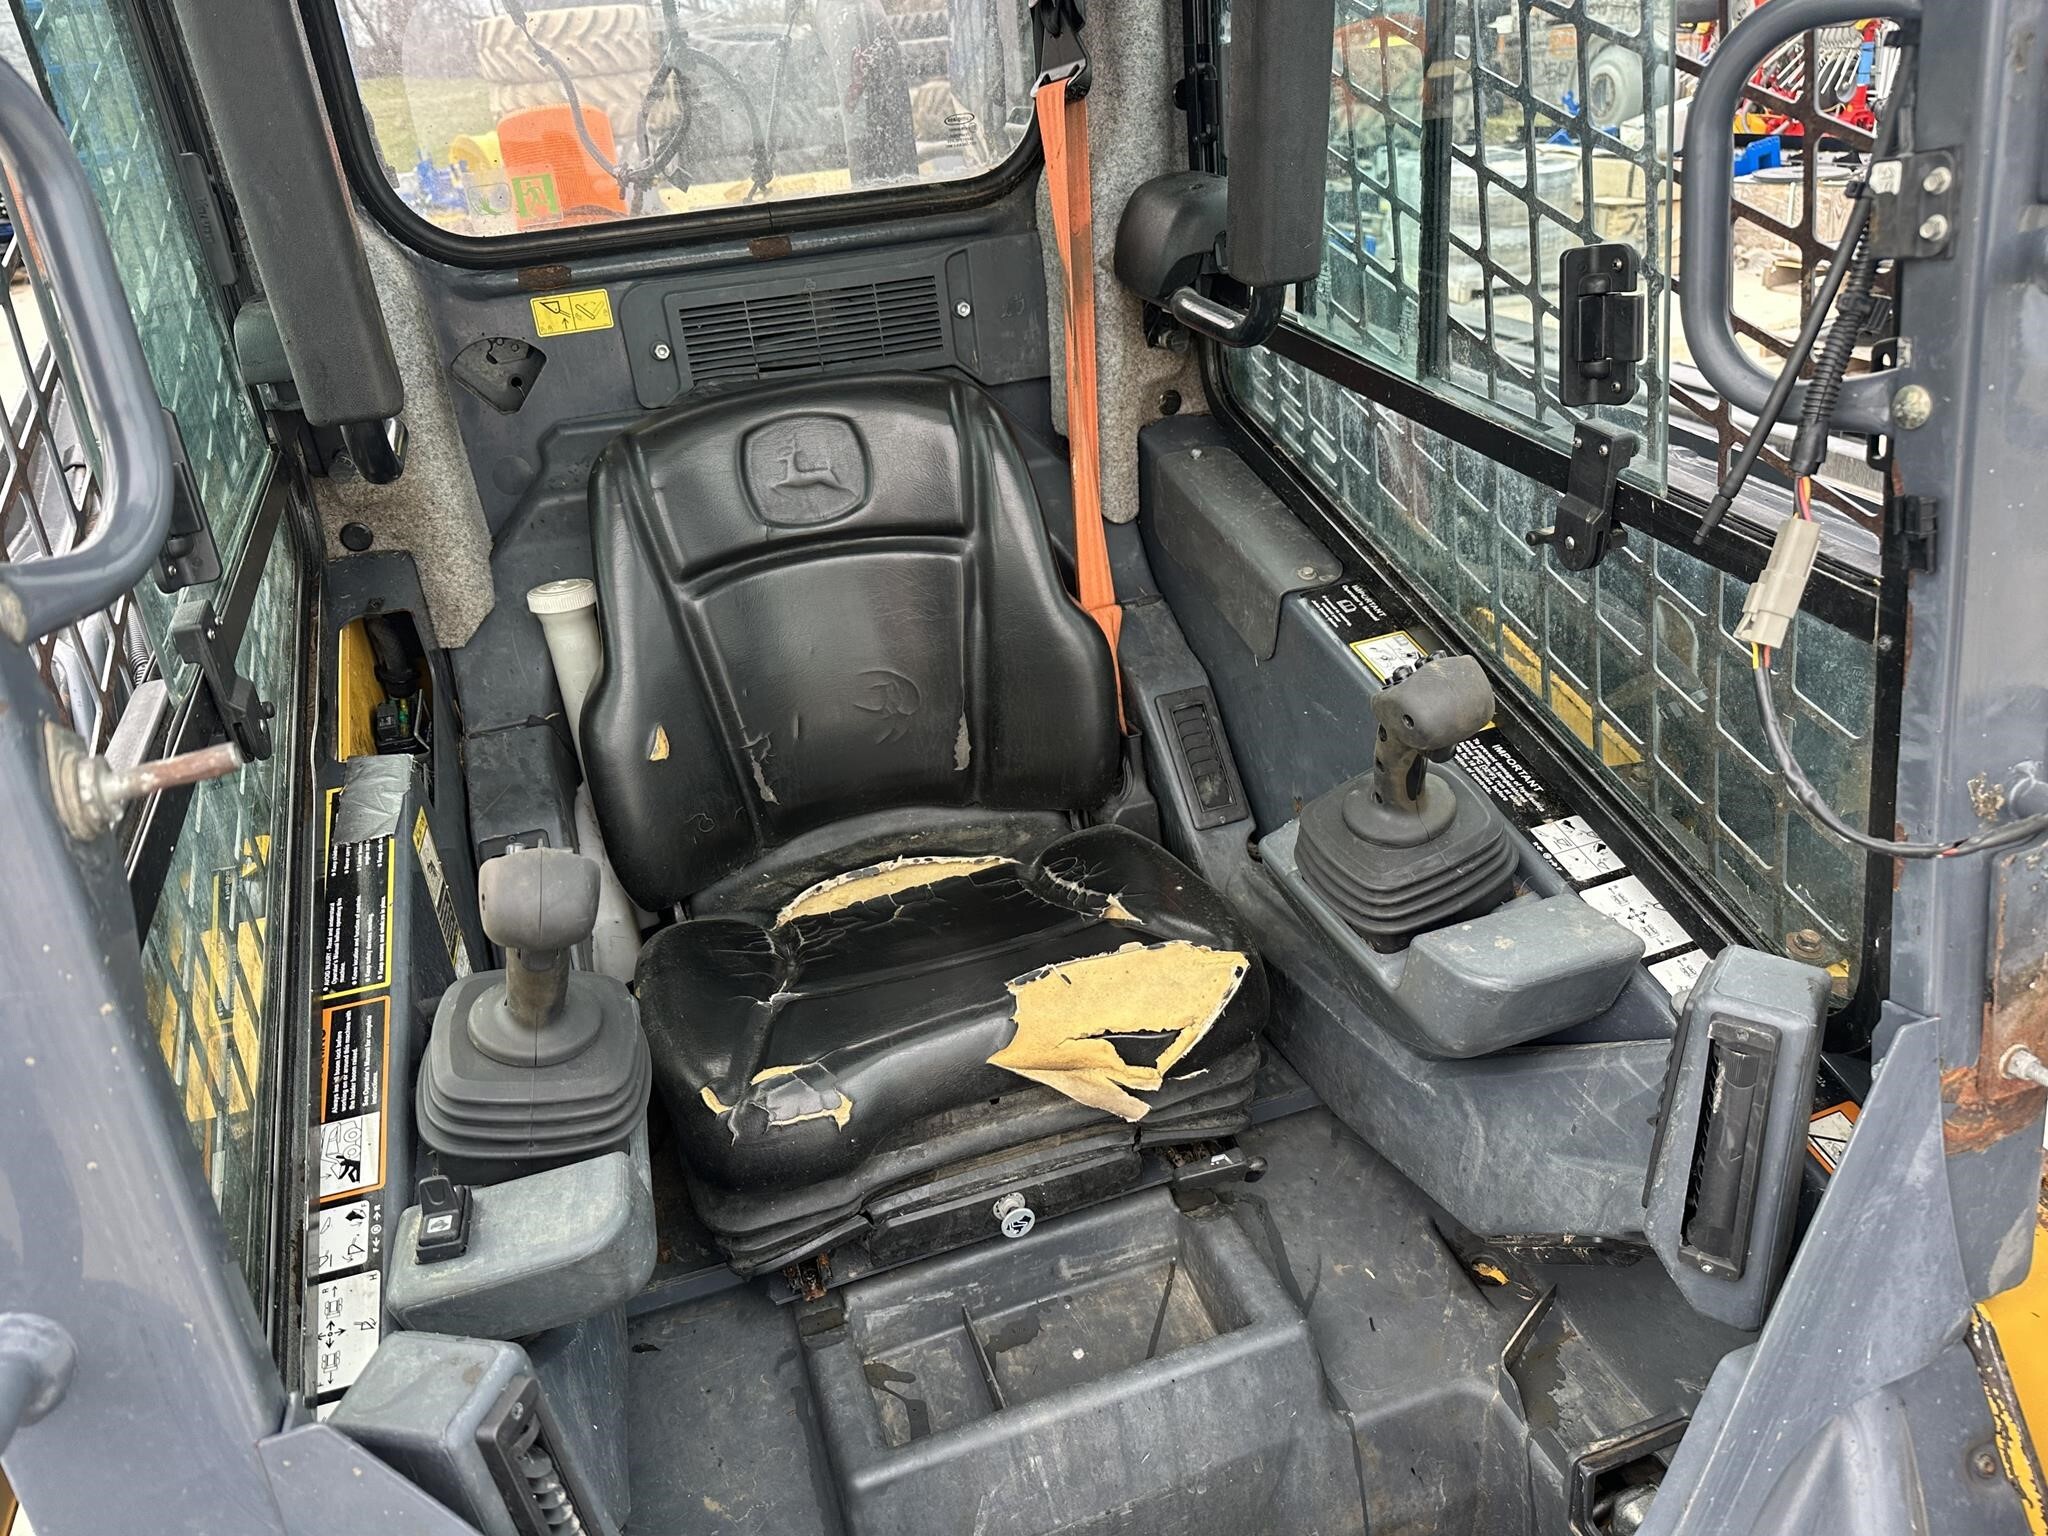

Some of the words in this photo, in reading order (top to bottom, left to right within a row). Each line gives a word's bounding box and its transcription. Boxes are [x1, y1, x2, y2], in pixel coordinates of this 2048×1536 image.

[1352, 585, 1386, 617] IMPORTANT
[1466, 740, 1476, 749] and
[1478, 744, 1497, 762] prevent
[1495, 762, 1515, 780] damage
[1492, 744, 1544, 793] IMPORTANT
[1473, 766, 1494, 785] minutes
[1491, 785, 1509, 801] before
[1495, 780, 1506, 789] run
[332, 1094, 340, 1113] Always
[340, 1089, 348, 1111] working
